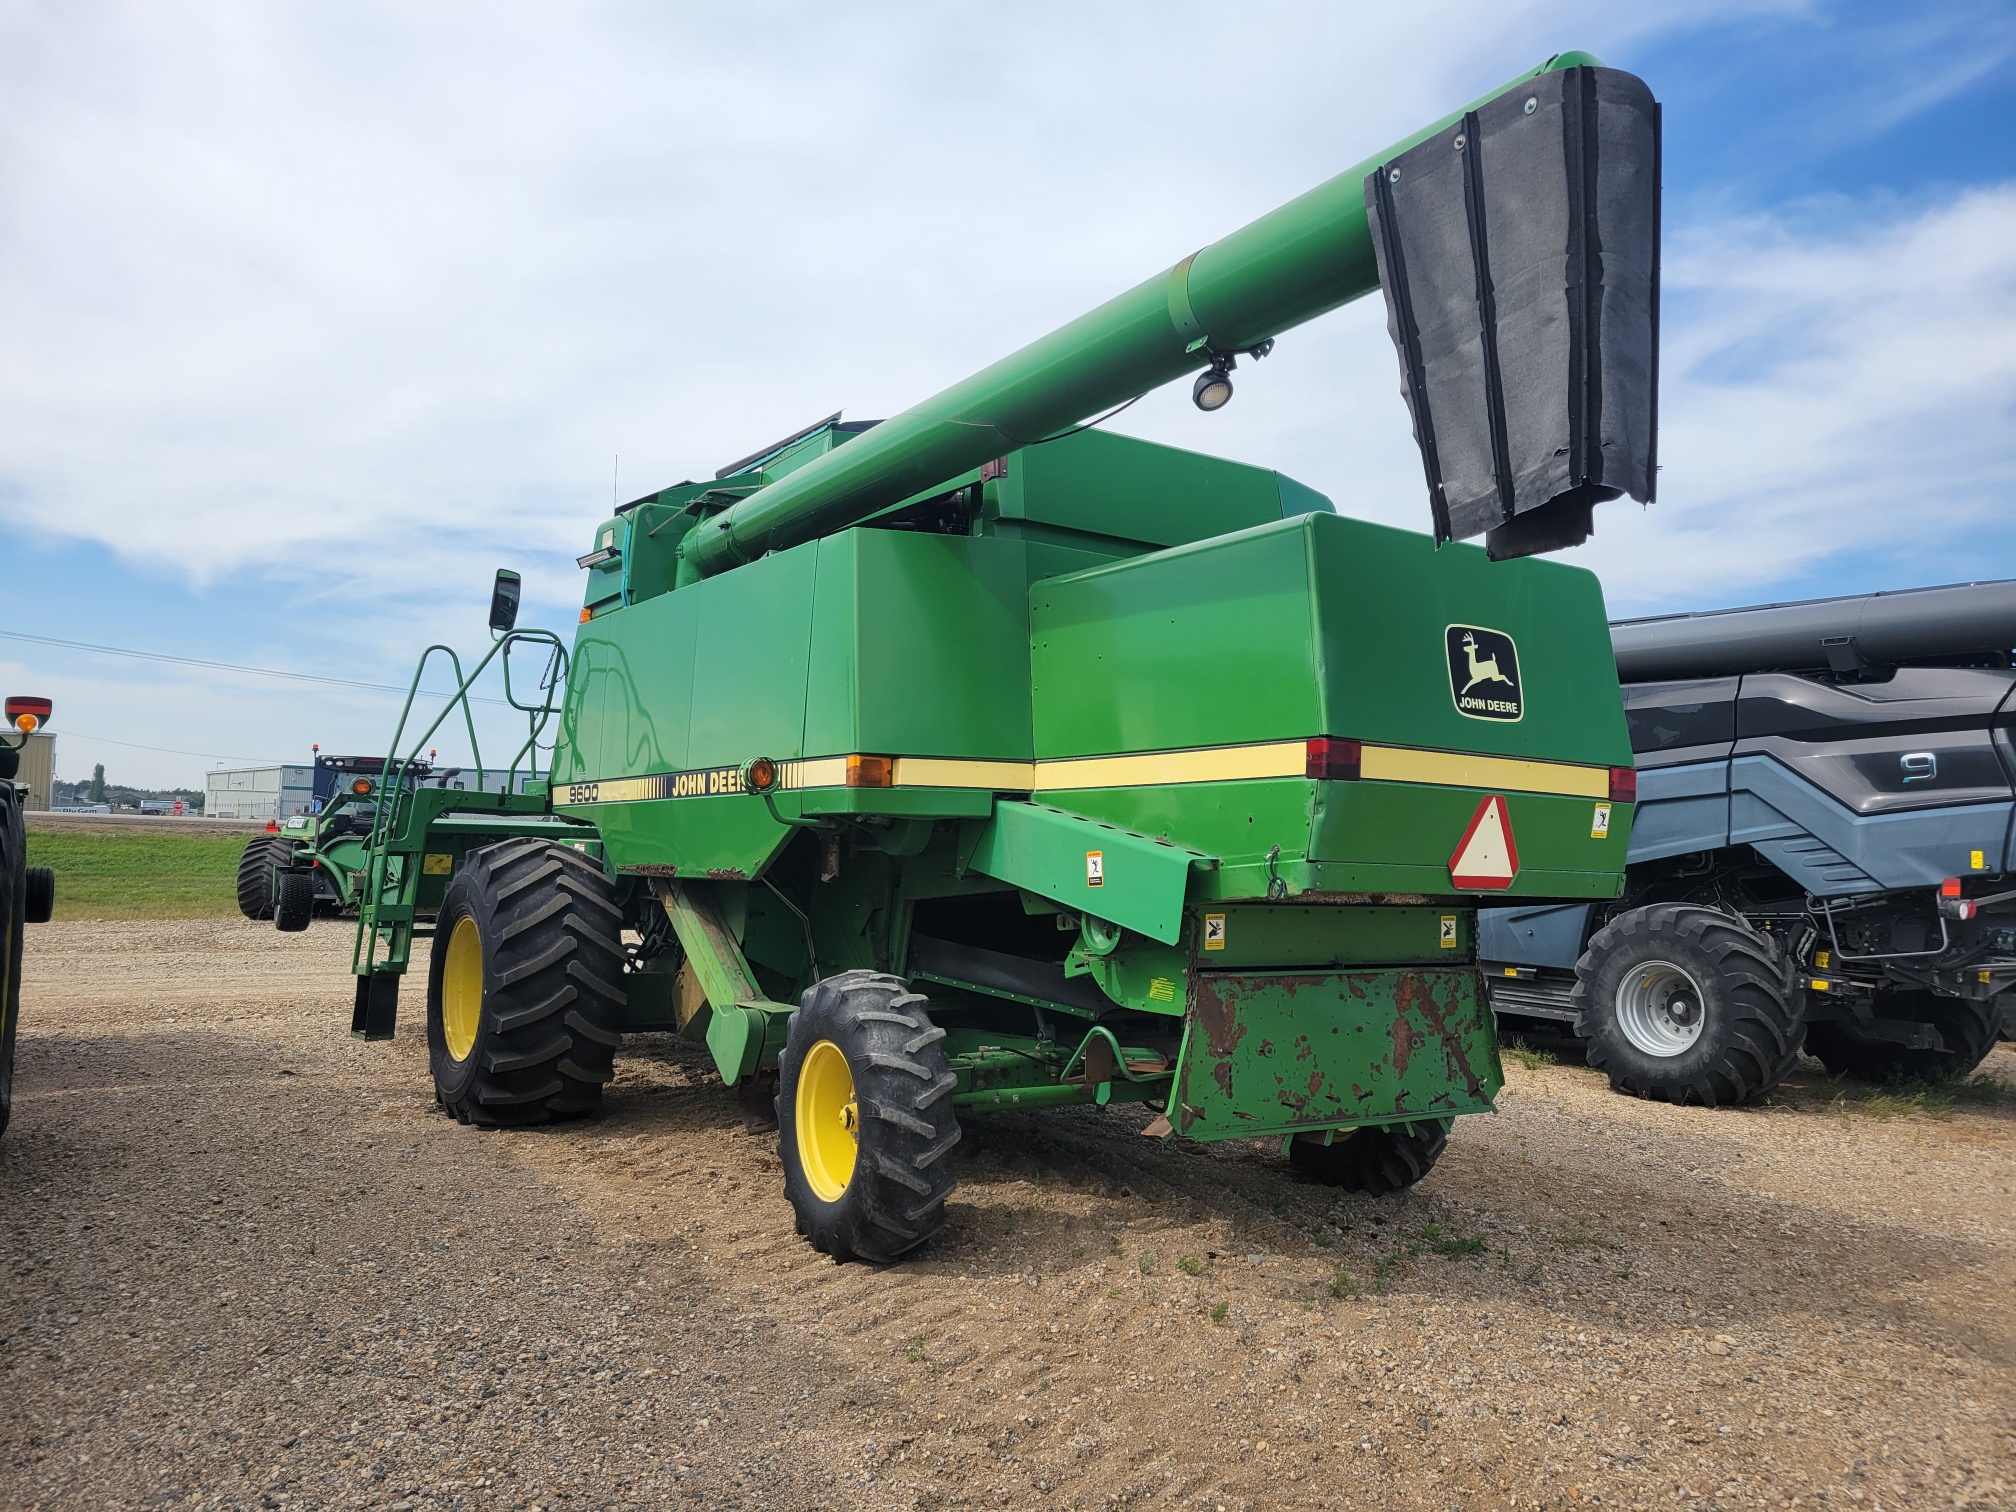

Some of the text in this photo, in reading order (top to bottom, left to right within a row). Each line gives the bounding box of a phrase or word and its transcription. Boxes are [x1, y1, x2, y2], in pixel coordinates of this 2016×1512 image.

[1459, 696, 1519, 714] JOHN DEERE
[1900, 752, 1937, 784] 9
[569, 783, 599, 804] 9600
[672, 769, 747, 797] JOHN DEER
